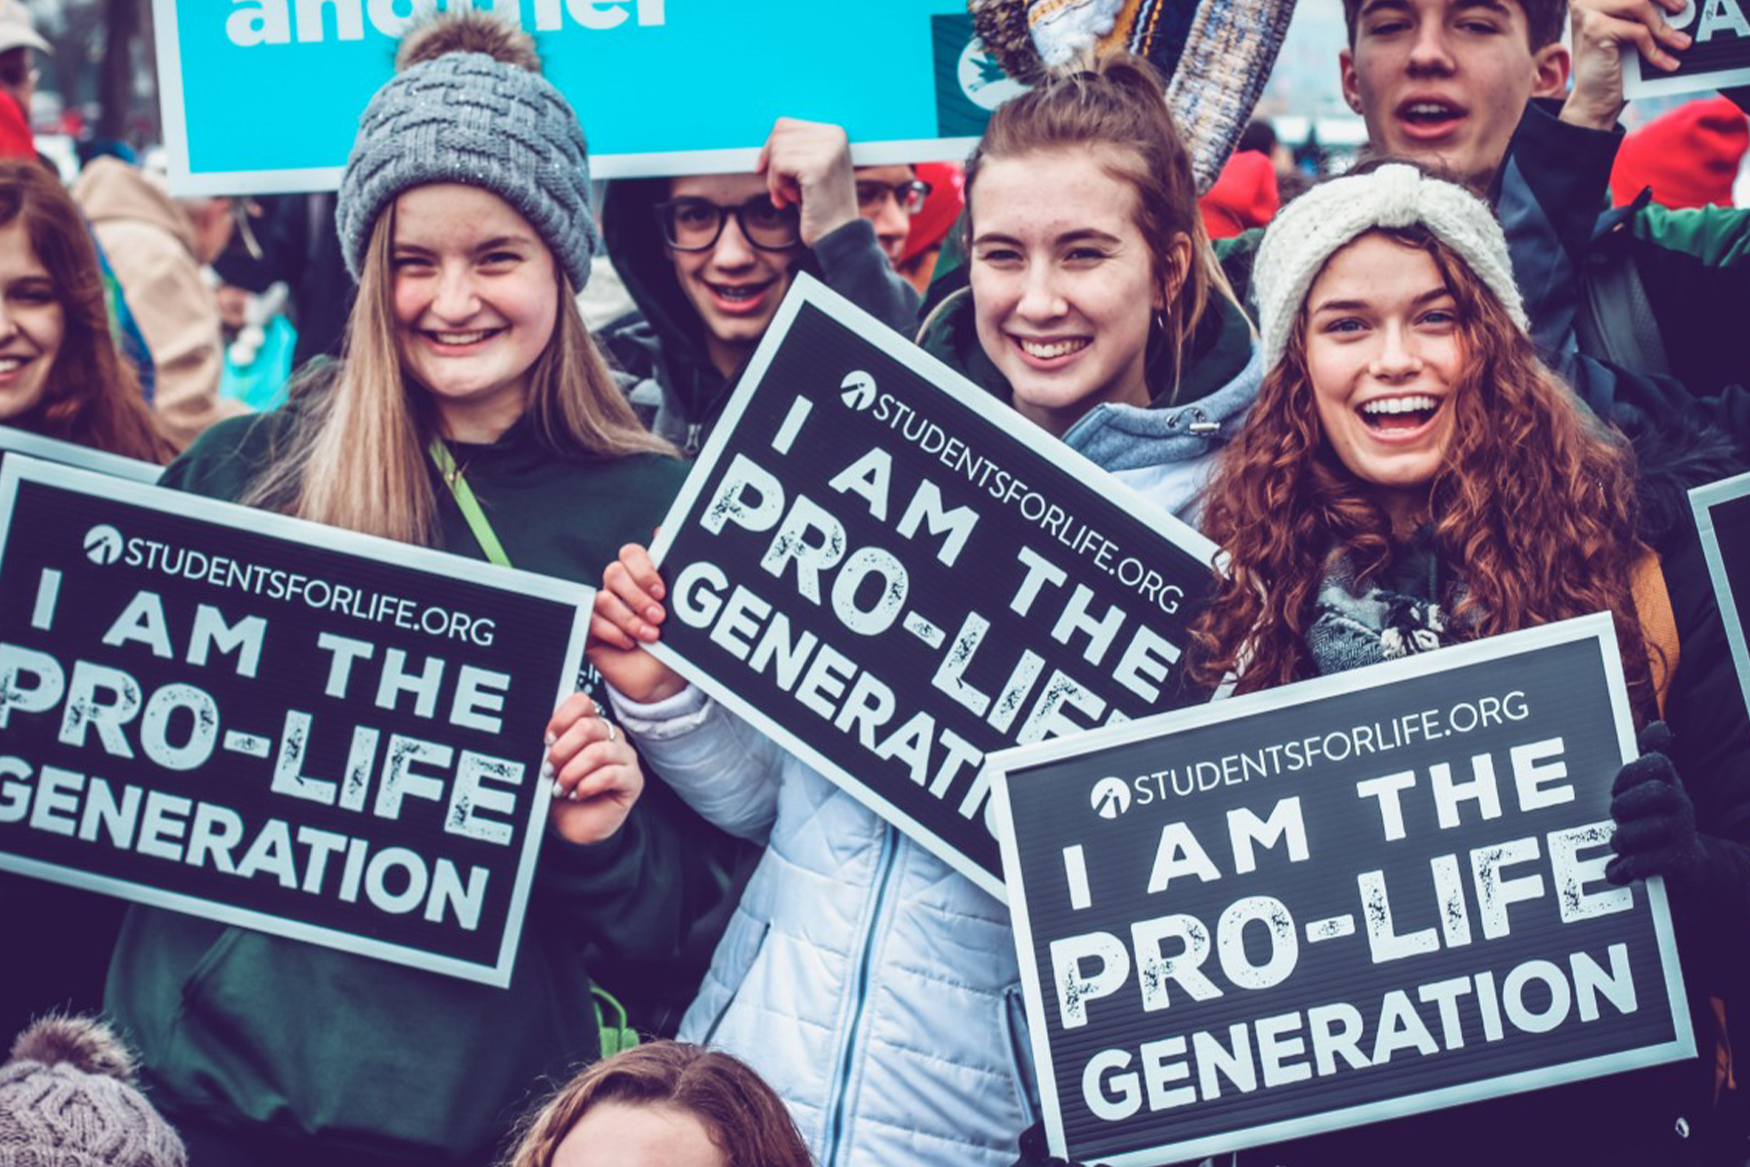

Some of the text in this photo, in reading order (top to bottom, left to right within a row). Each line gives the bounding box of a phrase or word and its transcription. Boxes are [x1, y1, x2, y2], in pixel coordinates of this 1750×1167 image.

[124, 538, 495, 646] STUDENTSFORLIFE.ORG
[772, 395, 1181, 703] I AM THE
[873, 394, 1183, 613] STUDENTSFORLIFE.ORG
[32, 569, 510, 733] I AM THE
[700, 453, 1132, 746] PRO-LIF
[0, 642, 525, 845] PRO-LIFE
[672, 562, 1000, 842] GENERATI
[1134, 691, 1529, 804] STUDENTSFORLIFE.ORG
[0, 756, 489, 930] GENERATION
[1063, 737, 1575, 910] I AM THE
[1050, 819, 1633, 1029] PRO-LIFE
[1082, 943, 1637, 1120] GENERATION
